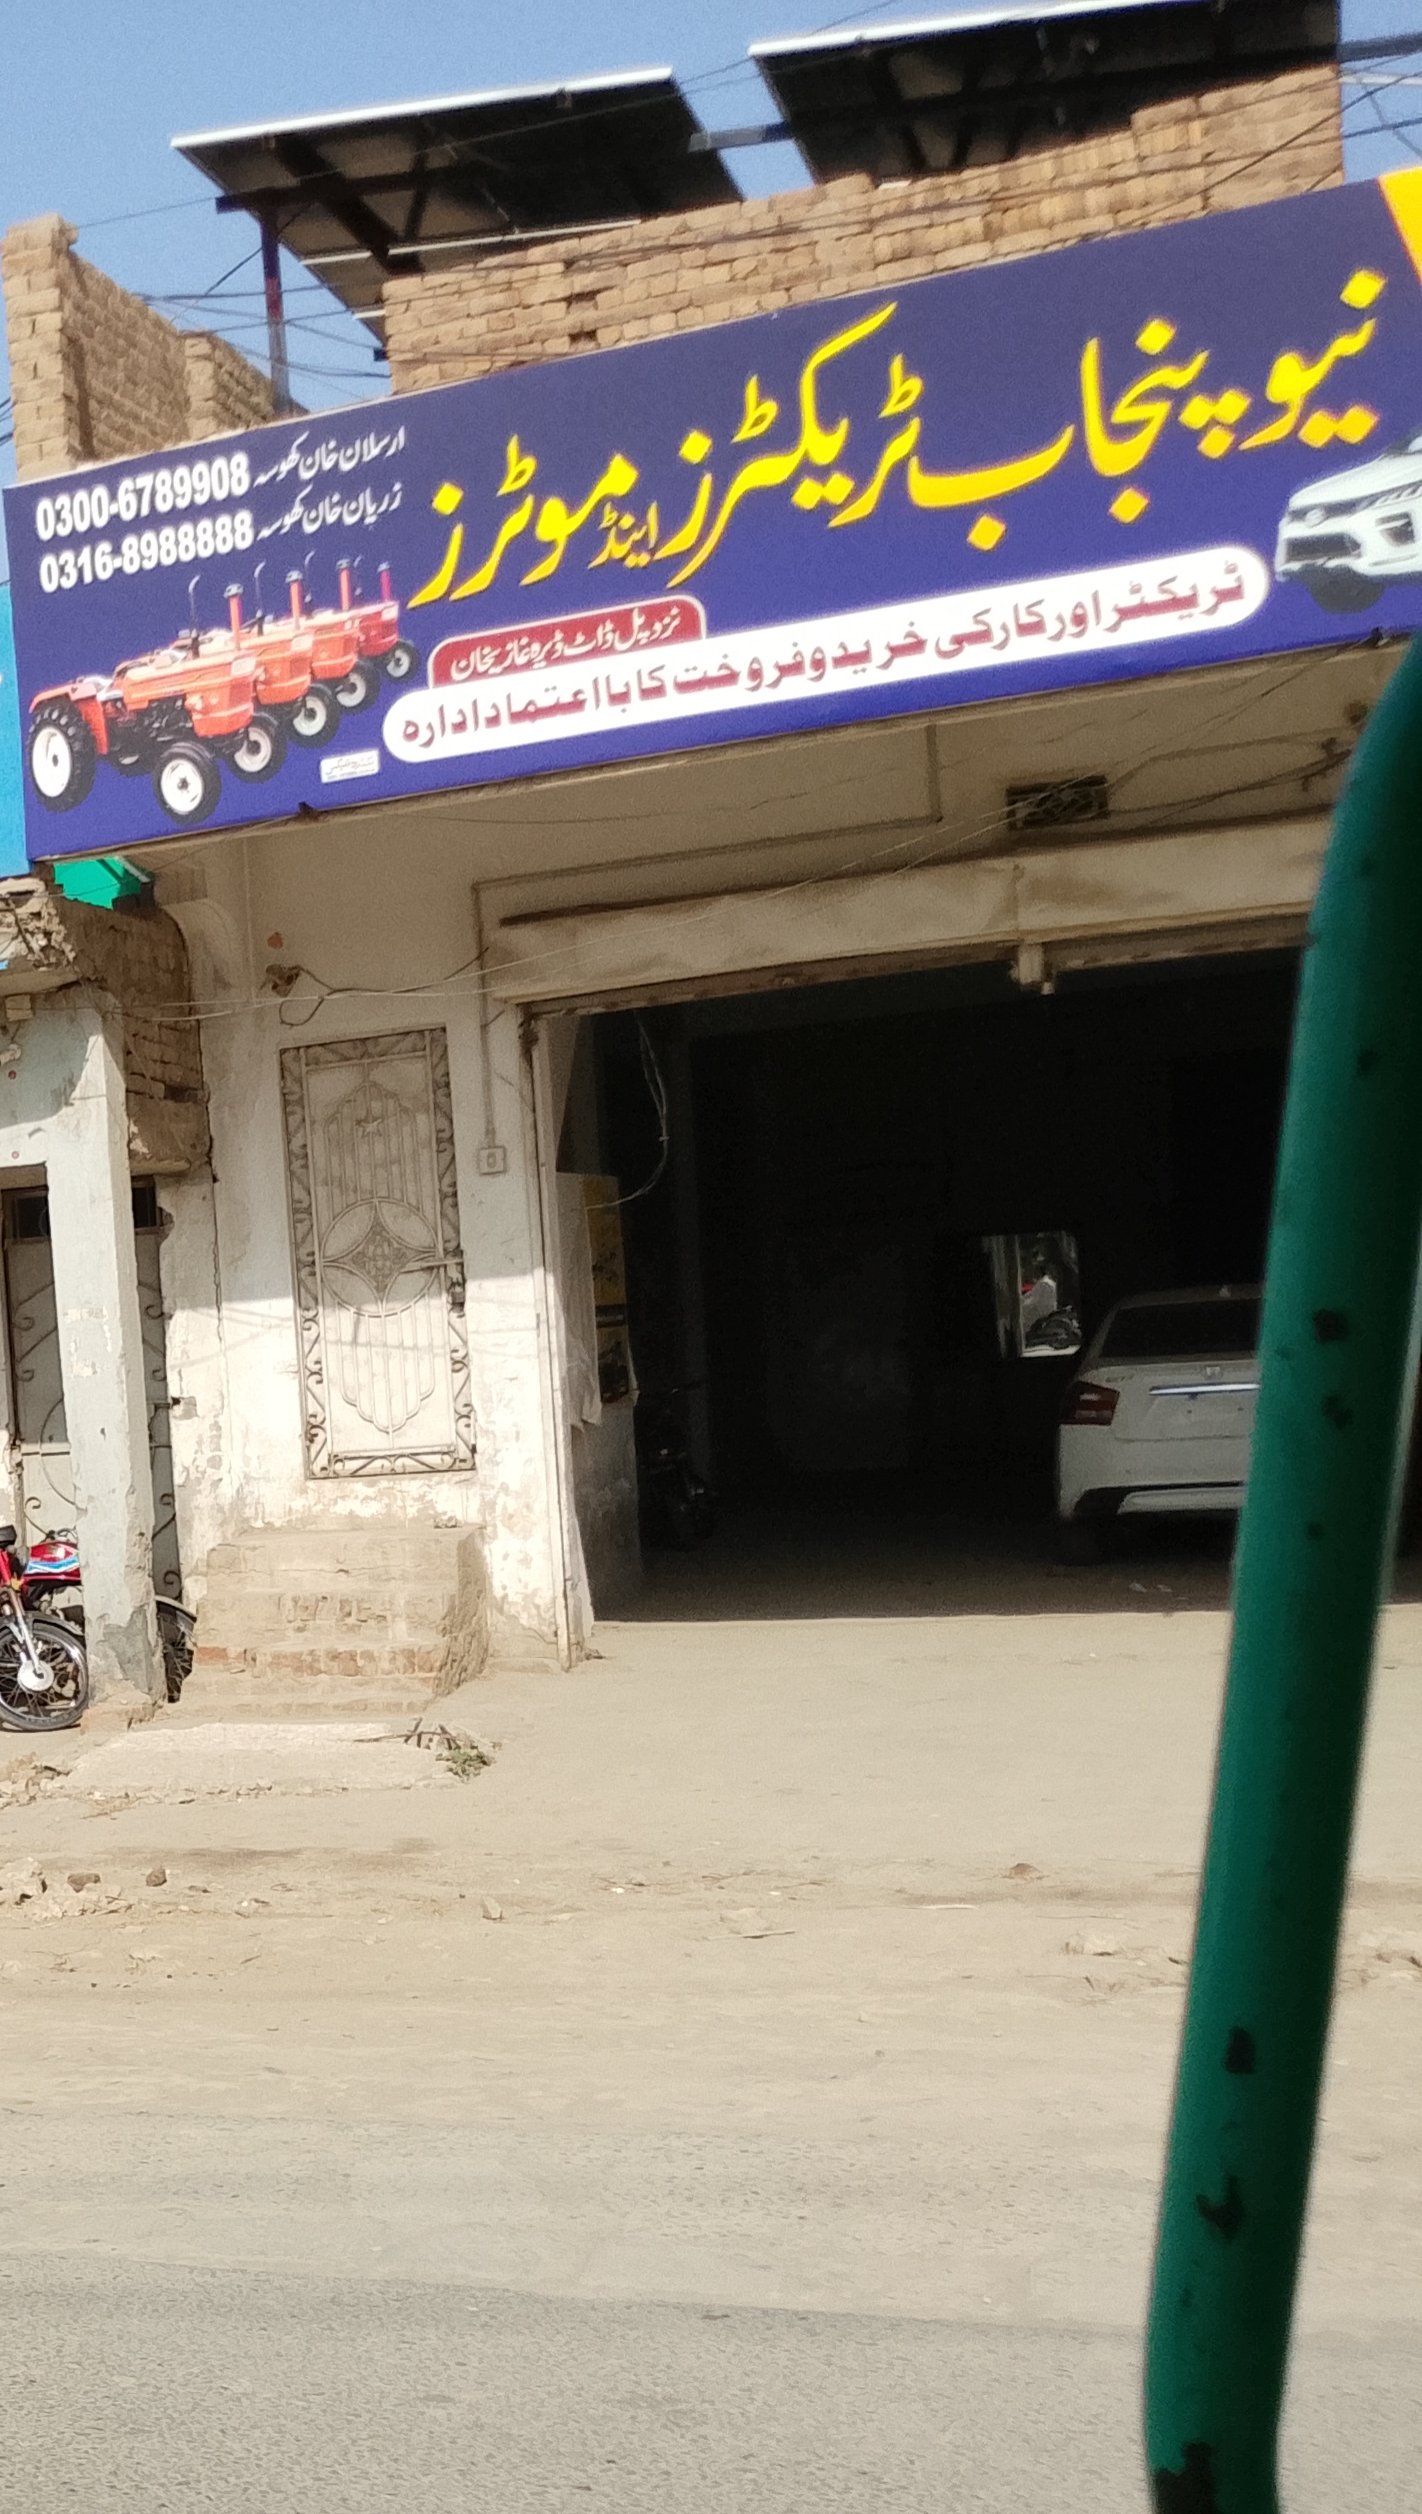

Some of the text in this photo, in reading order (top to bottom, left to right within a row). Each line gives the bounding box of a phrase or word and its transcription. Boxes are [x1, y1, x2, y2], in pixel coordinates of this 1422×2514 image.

[1240, 269, 1386, 452] نیو
[298, 439, 338, 480] خان
[338, 425, 405, 472] ارسلان
[906, 318, 1251, 552] پنجاب
[36, 453, 250, 541] 0300-6789908
[302, 492, 342, 534] خان
[405, 433, 640, 610] موٹرز
[39, 510, 254, 593] 0316-8988888
[587, 500, 658, 570] اینڈ
[1047, 589, 1101, 642] اور
[1104, 559, 1246, 633] ٹریکٹر
[614, 607, 645, 650] پل
[649, 605, 681, 641] نزد
[830, 621, 928, 676] خرید
[934, 607, 994, 660] کی
[991, 598, 1048, 651] کار
[637, 664, 667, 702] کا
[672, 641, 806, 694] فروخت
